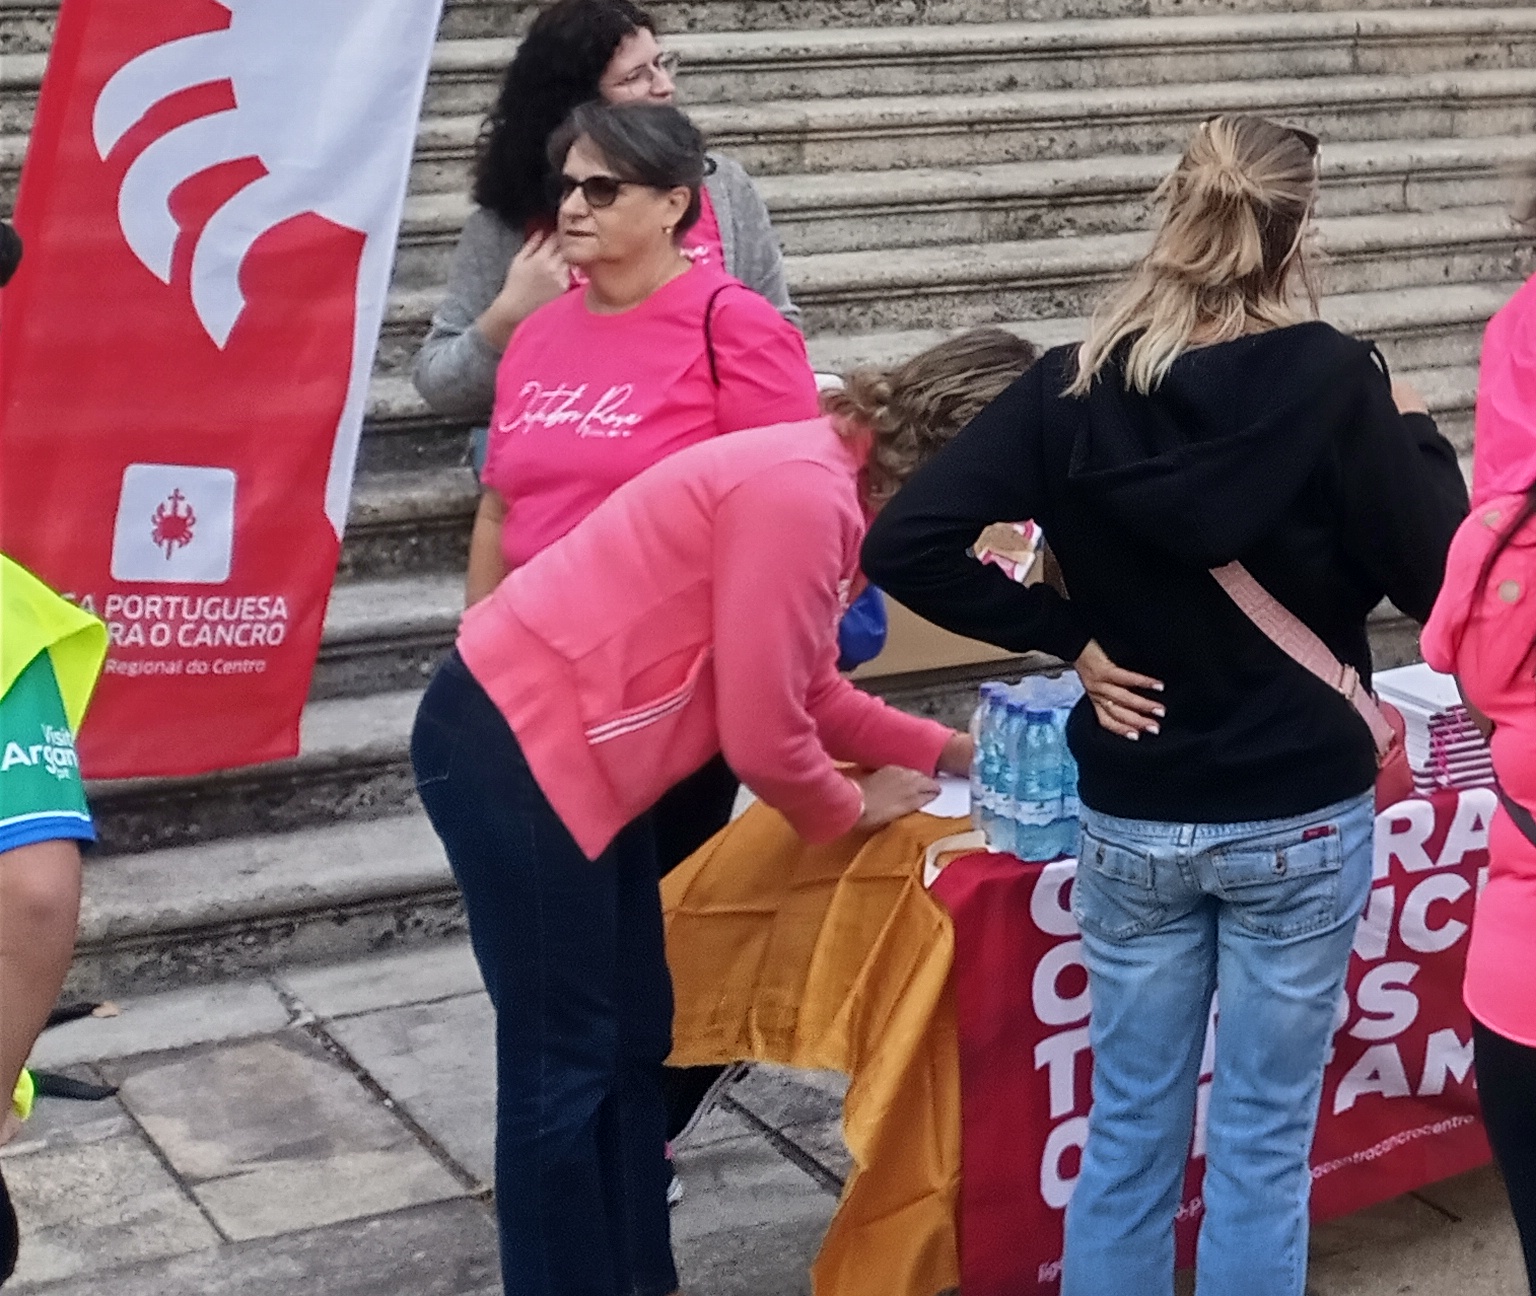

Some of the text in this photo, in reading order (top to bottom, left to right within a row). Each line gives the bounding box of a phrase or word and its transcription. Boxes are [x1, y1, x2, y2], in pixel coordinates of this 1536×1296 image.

[104, 594, 287, 620] PORTUGUESA
[150, 623, 171, 647] O
[177, 623, 285, 647] CANCRO
[105, 658, 265, 677] Regional do Centro
[0, 741, 79, 774] Argan
